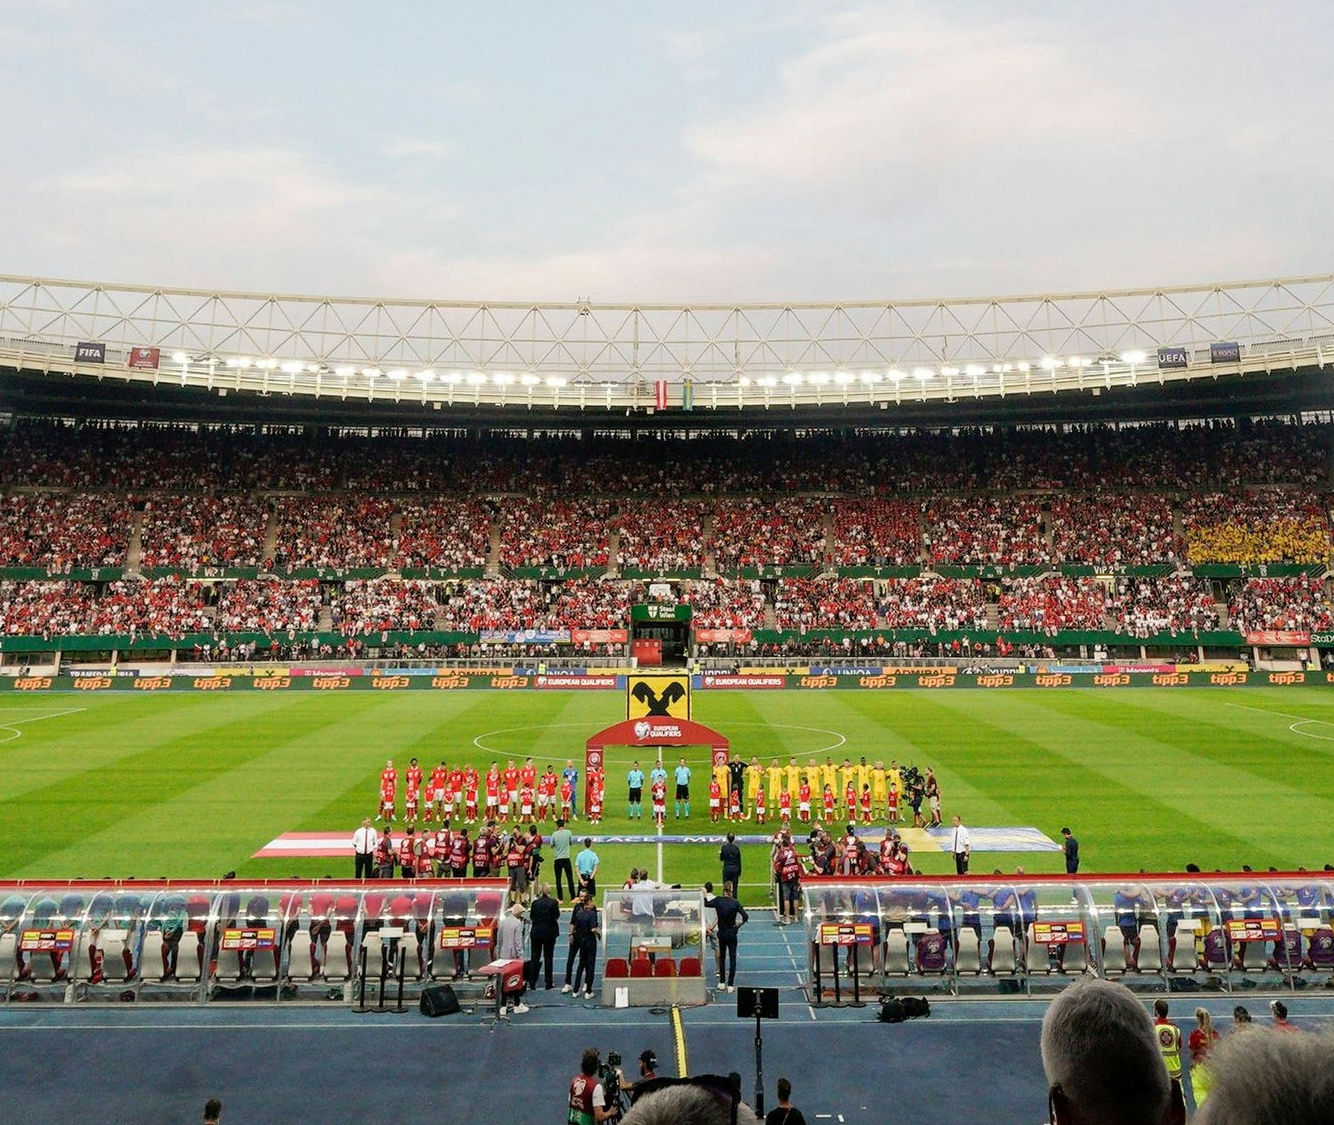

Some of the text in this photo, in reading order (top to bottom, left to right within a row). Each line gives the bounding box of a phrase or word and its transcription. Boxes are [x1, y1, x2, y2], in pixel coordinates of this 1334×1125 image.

[78, 348, 101, 358] FIFA
[1158, 353, 1186, 363] UEFA
[14, 676, 52, 691] tipp3
[74, 676, 112, 691] tipp3
[133, 676, 172, 691] tipp3
[193, 676, 232, 691] tipp3
[253, 676, 292, 690] tipp3
[312, 676, 351, 690] tipp3
[372, 676, 410, 690] tipp3
[432, 676, 469, 689] tipp3
[490, 676, 529, 689] tipp3
[548, 678, 615, 686] EUROPEAN QUALIFIERS
[715, 678, 782, 686] EUROPEAN QUALIFIERS
[800, 675, 838, 689] tipp3
[859, 674, 897, 688] tipp3
[918, 674, 956, 688] tipp3
[976, 674, 1014, 688] tipp3
[1035, 673, 1073, 687] tipp3
[1093, 673, 1131, 687] tipp3
[1152, 673, 1189, 686] tipp3
[1210, 672, 1247, 686] tipp3
[1268, 672, 1305, 685] tipp3
[650, 730, 682, 738] QUALIFIERS
